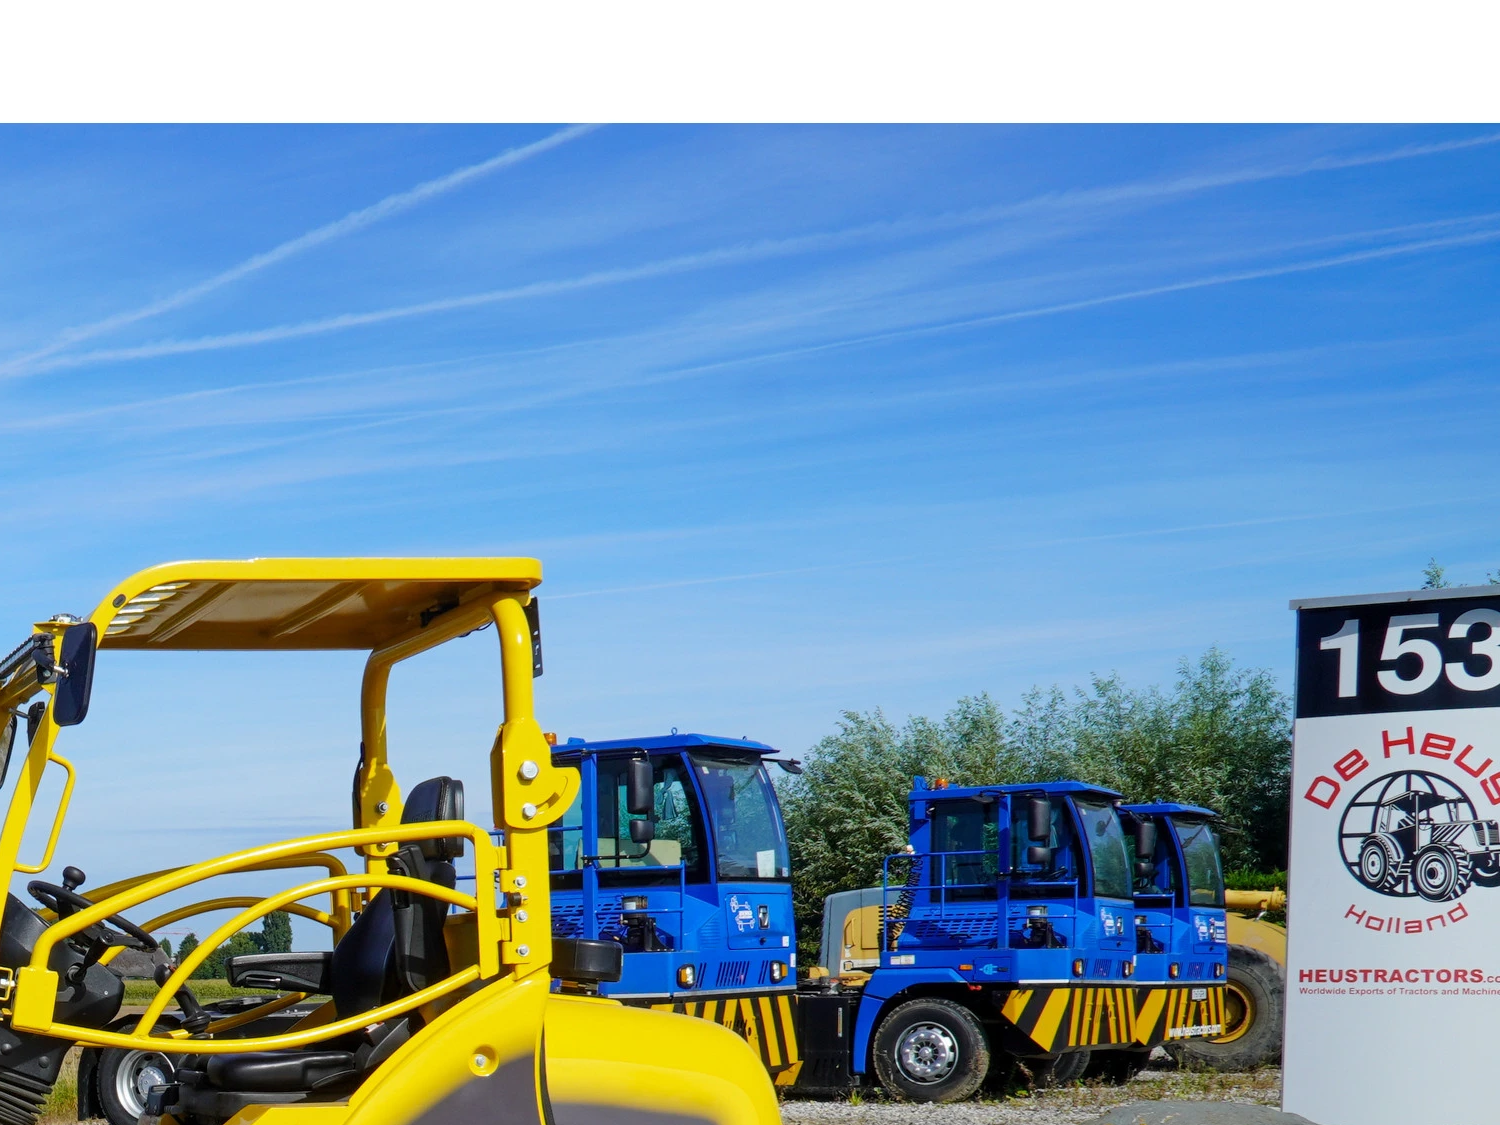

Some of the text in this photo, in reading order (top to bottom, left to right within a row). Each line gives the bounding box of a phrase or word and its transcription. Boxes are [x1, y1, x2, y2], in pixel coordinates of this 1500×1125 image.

[1304, 748, 1370, 810] De
[1344, 902, 1469, 934] Holland
[1299, 987, 1347, 995] Worldwide
[1349, 987, 1385, 997] Exports
[1387, 987, 1398, 995] of
[1399, 987, 1439, 995] Tractors
[1441, 987, 1460, 995] and
